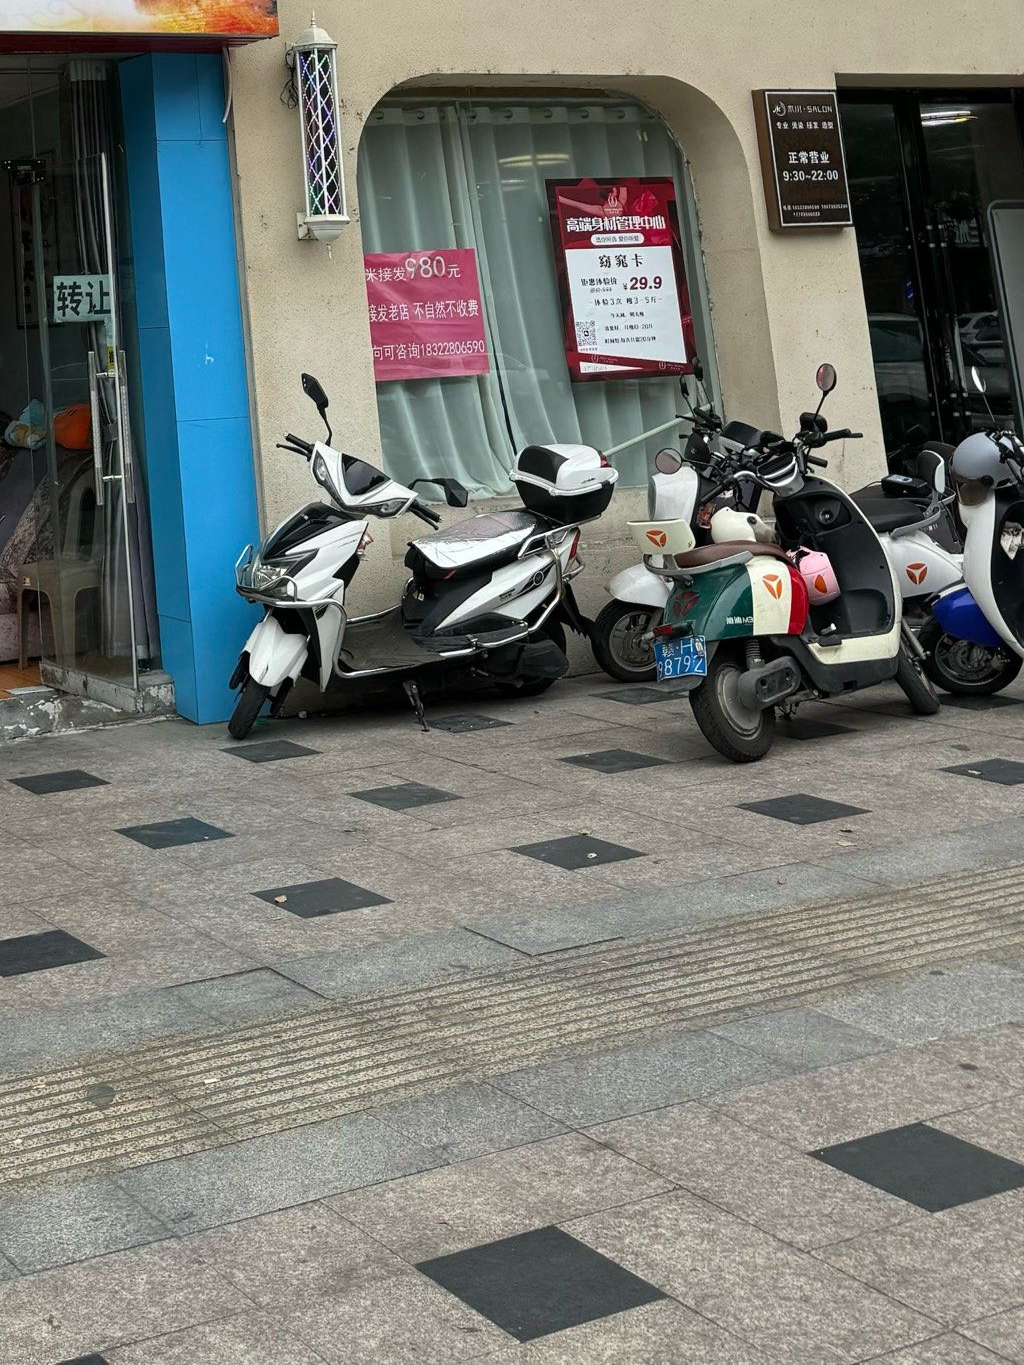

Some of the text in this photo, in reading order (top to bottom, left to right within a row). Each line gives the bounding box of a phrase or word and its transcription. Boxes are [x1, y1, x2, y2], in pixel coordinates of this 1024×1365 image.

[788, 151, 830, 164] 正常营业
[783, 170, 839, 181] 9:30~22:00
[566, 215, 666, 232] 高端身材管理中心
[57, 280, 111, 317] 转让
[369, 299, 479, 322] 接发老店 不自然不收费
